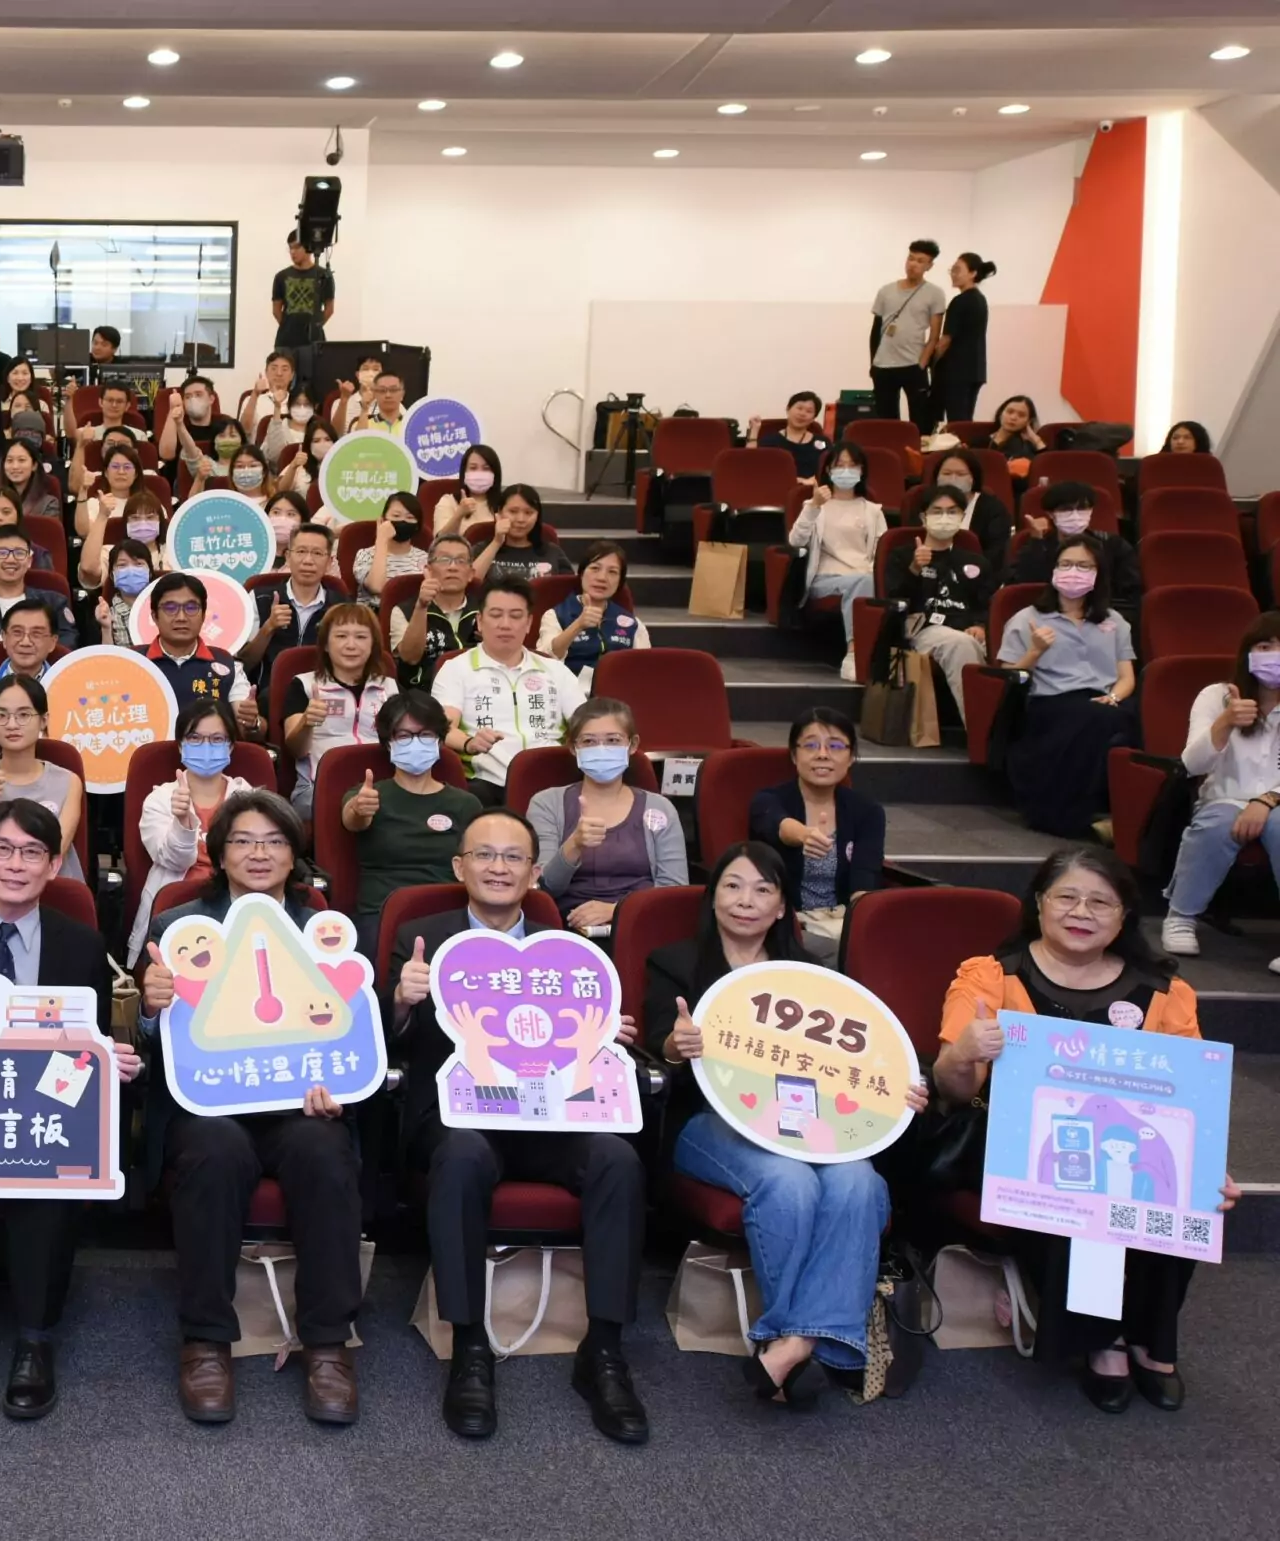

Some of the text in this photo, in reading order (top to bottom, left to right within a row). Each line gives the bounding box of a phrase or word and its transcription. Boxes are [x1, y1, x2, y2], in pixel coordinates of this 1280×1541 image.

[64, 704, 149, 731] 八德心理
[672, 772, 698, 785] 貴賓
[449, 966, 602, 999] 心理諮商
[750, 992, 867, 1054] 1925
[194, 1048, 360, 1088] 心情溫度計
[718, 1029, 891, 1097] 衛福部安心專線
